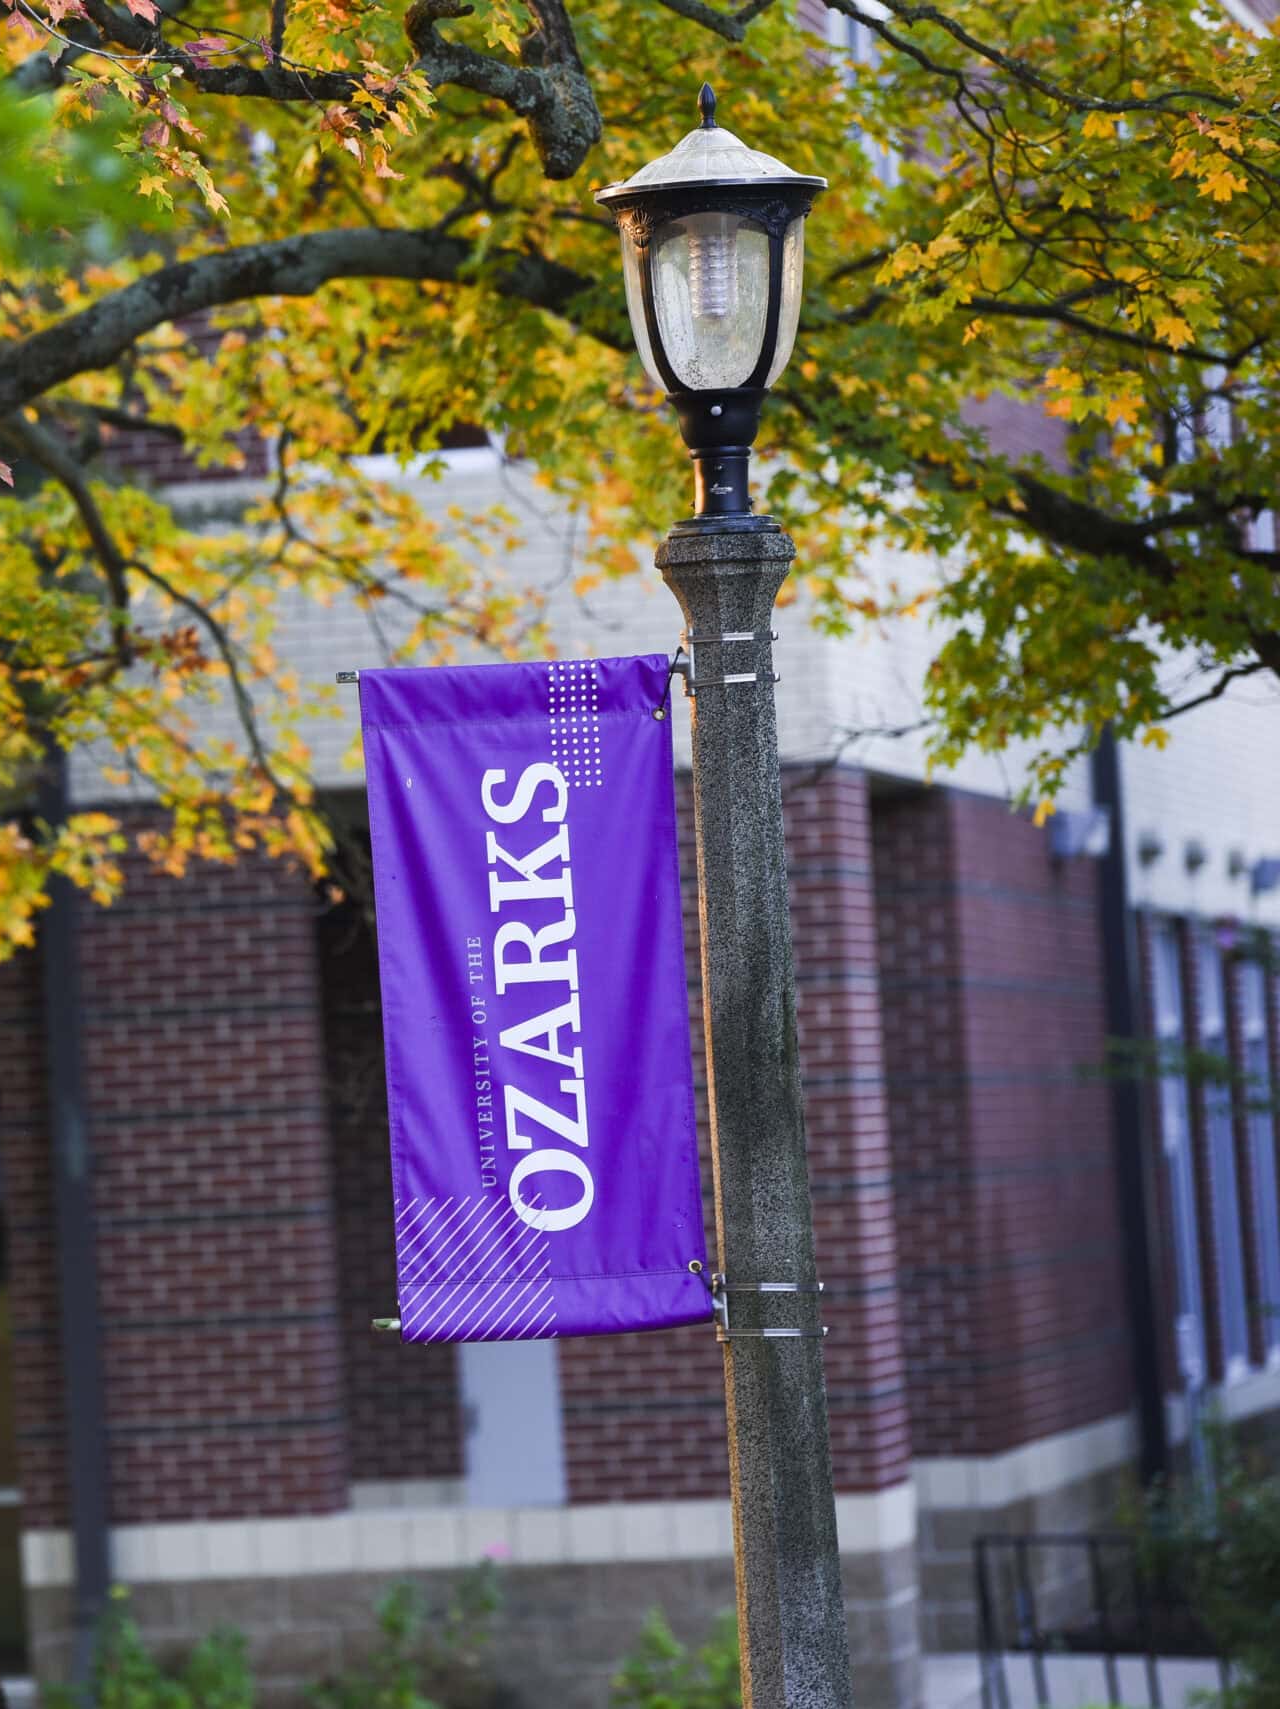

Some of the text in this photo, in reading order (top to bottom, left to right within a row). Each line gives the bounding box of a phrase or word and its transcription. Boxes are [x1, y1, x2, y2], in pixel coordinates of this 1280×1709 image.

[467, 936, 497, 1188] UNIVERSITY OF THE
[481, 762, 595, 1232] OZARKS
